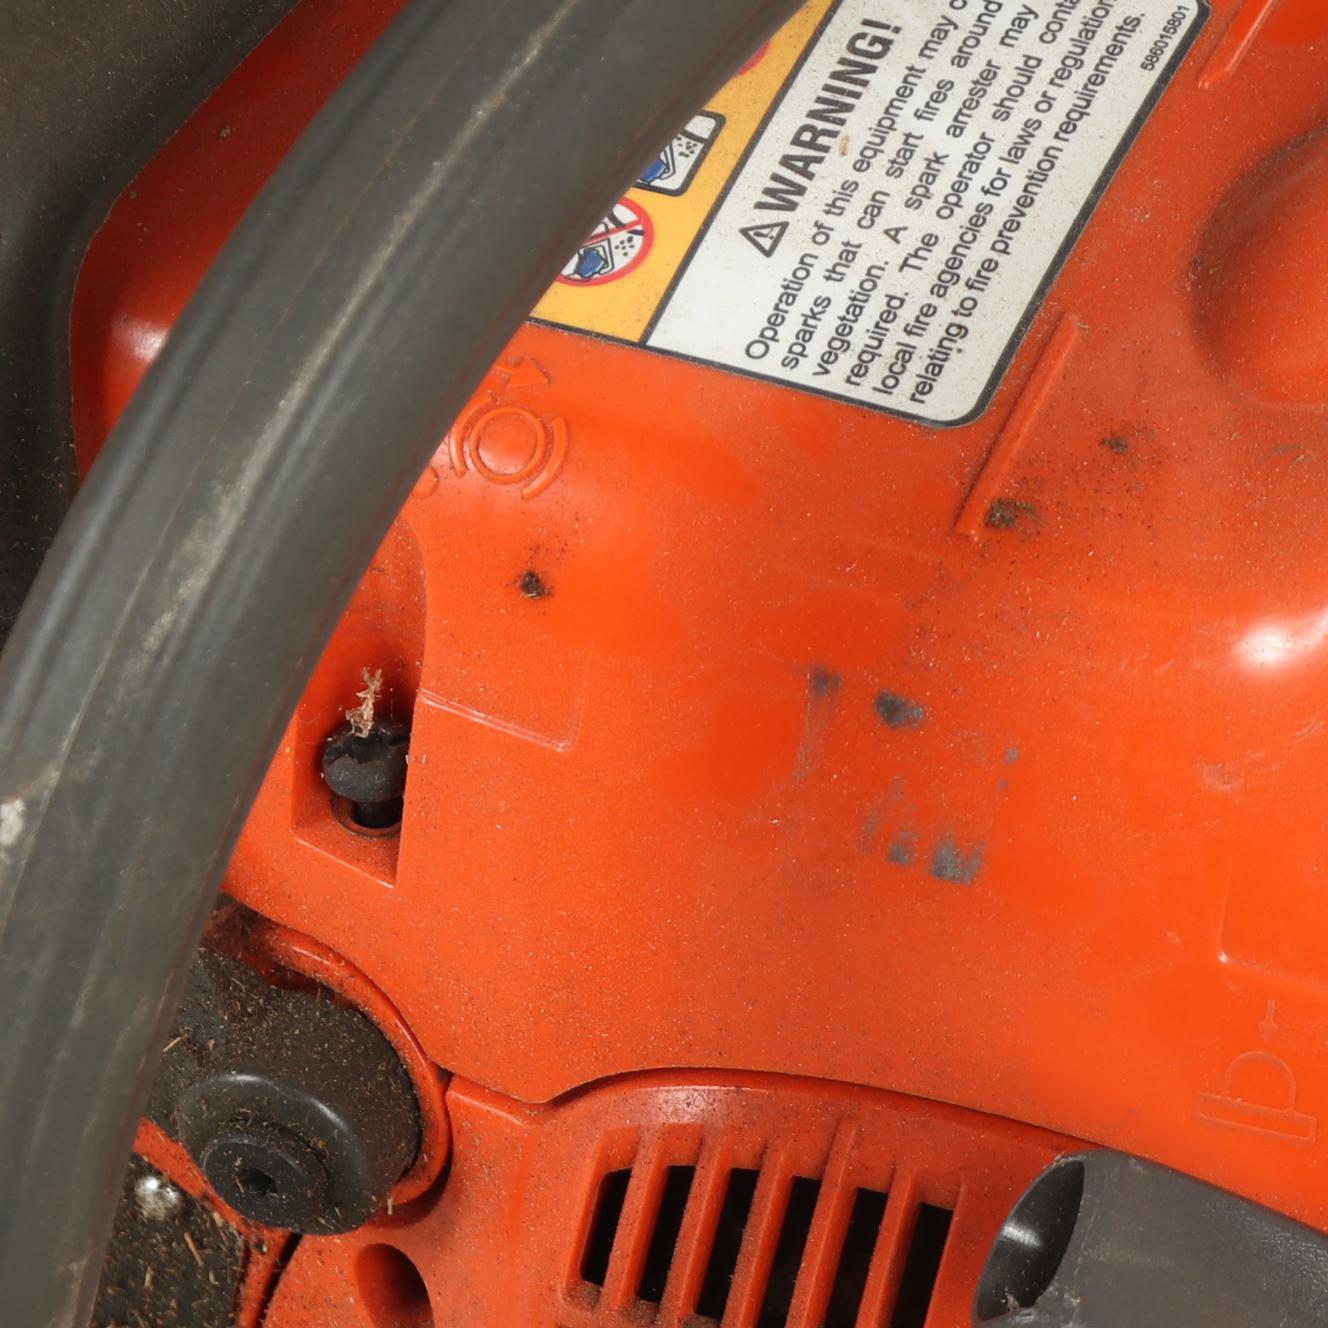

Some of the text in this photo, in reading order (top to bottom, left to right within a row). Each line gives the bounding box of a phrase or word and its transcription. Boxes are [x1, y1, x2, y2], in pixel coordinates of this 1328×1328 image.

[745, 254, 818, 359] Operation
[812, 221, 833, 245] of
[824, 180, 858, 216] this
[852, 65, 925, 172] equipment
[918, 15, 958, 59] may
[754, 18, 901, 211] WARNING!
[813, 262, 886, 376] vegetation.
[883, 227, 908, 244] A
[905, 152, 948, 210] spark
[947, 60, 1001, 138] arrester
[1000, 4, 1039, 47] may
[1140, 5, 1190, 71] 586015801
[782, 296, 831, 368] sparks
[823, 241, 861, 282] that
[857, 191, 889, 229] can
[885, 132, 923, 178] start
[913, 79, 954, 121] fires
[845, 292, 909, 386] required.
[899, 233, 939, 272] The
[936, 132, 994, 220] operator
[992, 54, 1042, 121] should
[872, 343, 916, 396] local
[903, 302, 938, 338] fire
[930, 202, 993, 298] agencies
[981, 167, 1011, 196] for
[1000, 118, 1042, 164] laws
[1034, 90, 1056, 113] or
[910, 13, 1146, 404] relating to fire prevention requirements.
